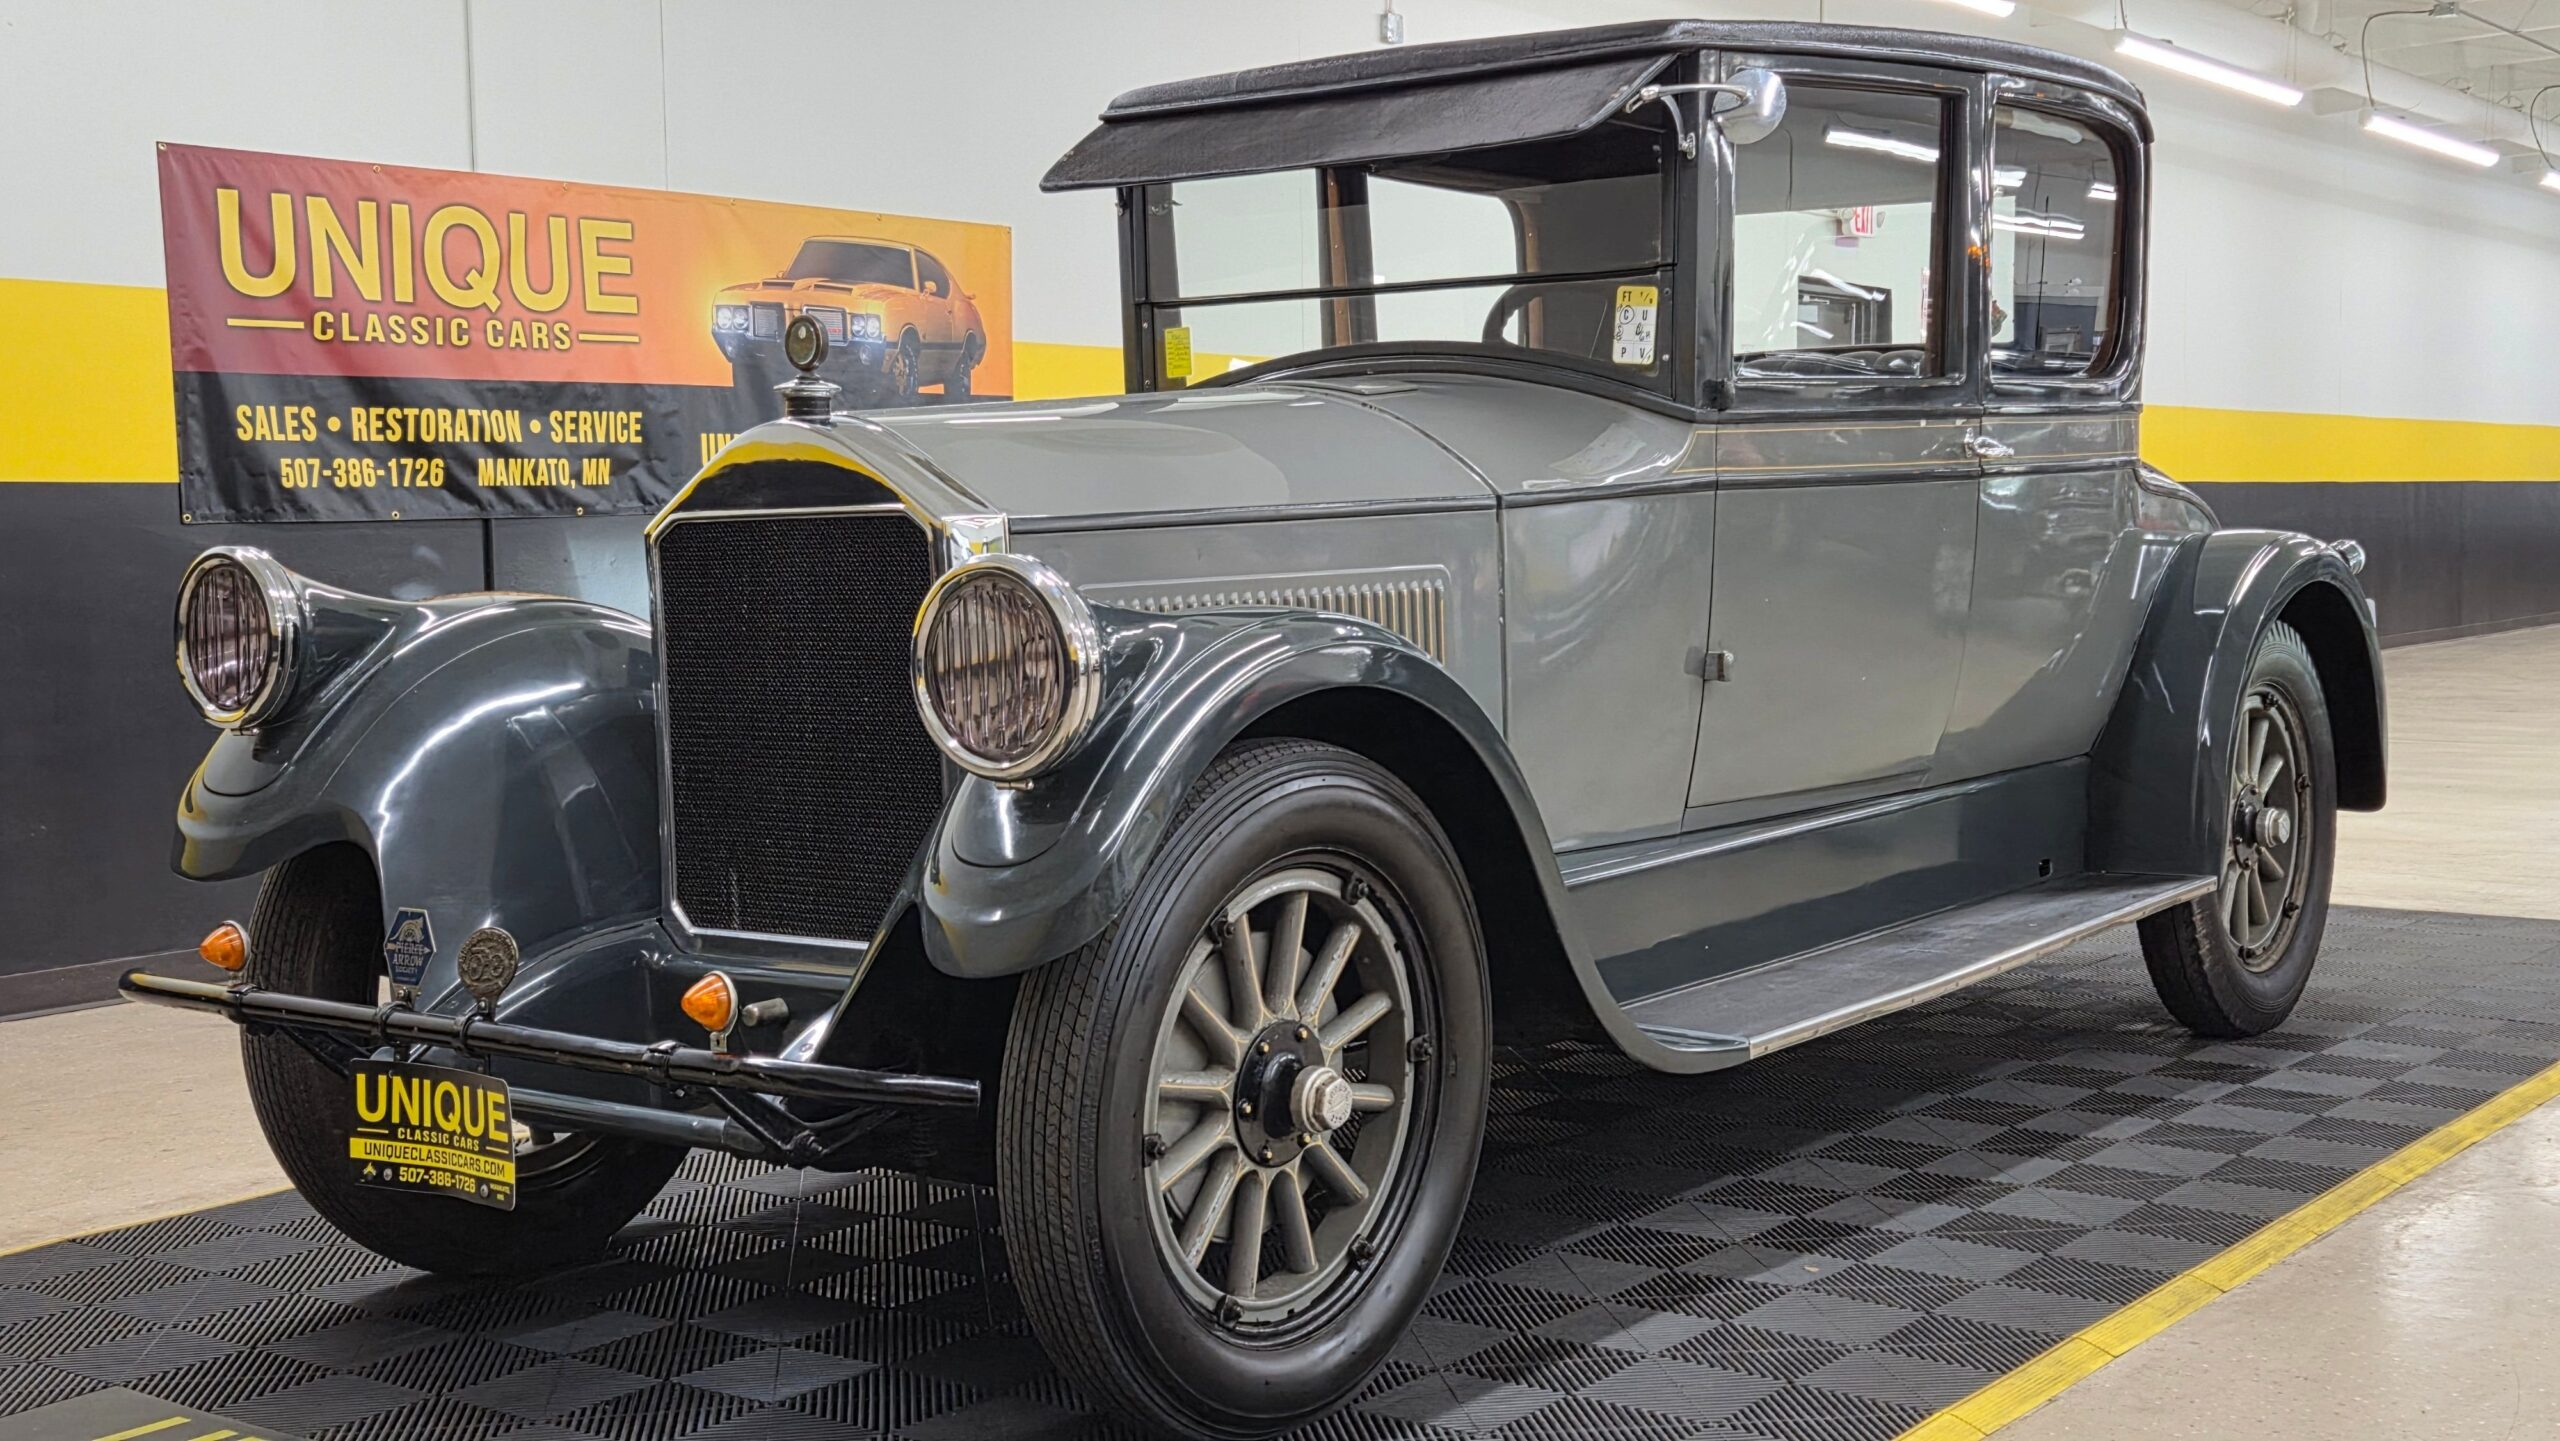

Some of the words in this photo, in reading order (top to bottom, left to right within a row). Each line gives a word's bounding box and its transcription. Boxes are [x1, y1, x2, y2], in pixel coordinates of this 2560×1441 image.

[216, 188, 638, 314] UNIQUE
[313, 311, 470, 346] CLASSIC
[486, 319, 572, 350] CARS
[236, 404, 317, 442] SALES
[352, 407, 521, 443] RESTORATION
[550, 410, 643, 443] SERVICE
[280, 458, 445, 488] 507-386-1726
[478, 457, 576, 489] MANKATO,
[582, 458, 610, 486] MN
[392, 953, 424, 967] ARROW
[356, 1073, 509, 1143] UNIQUE
[397, 1127, 450, 1145] CLASSIC
[453, 1135, 480, 1152] CARS
[364, 1141, 505, 1178] UNIQUECLASSICCARS.COM
[399, 1166, 476, 1194] 507-386-1726
